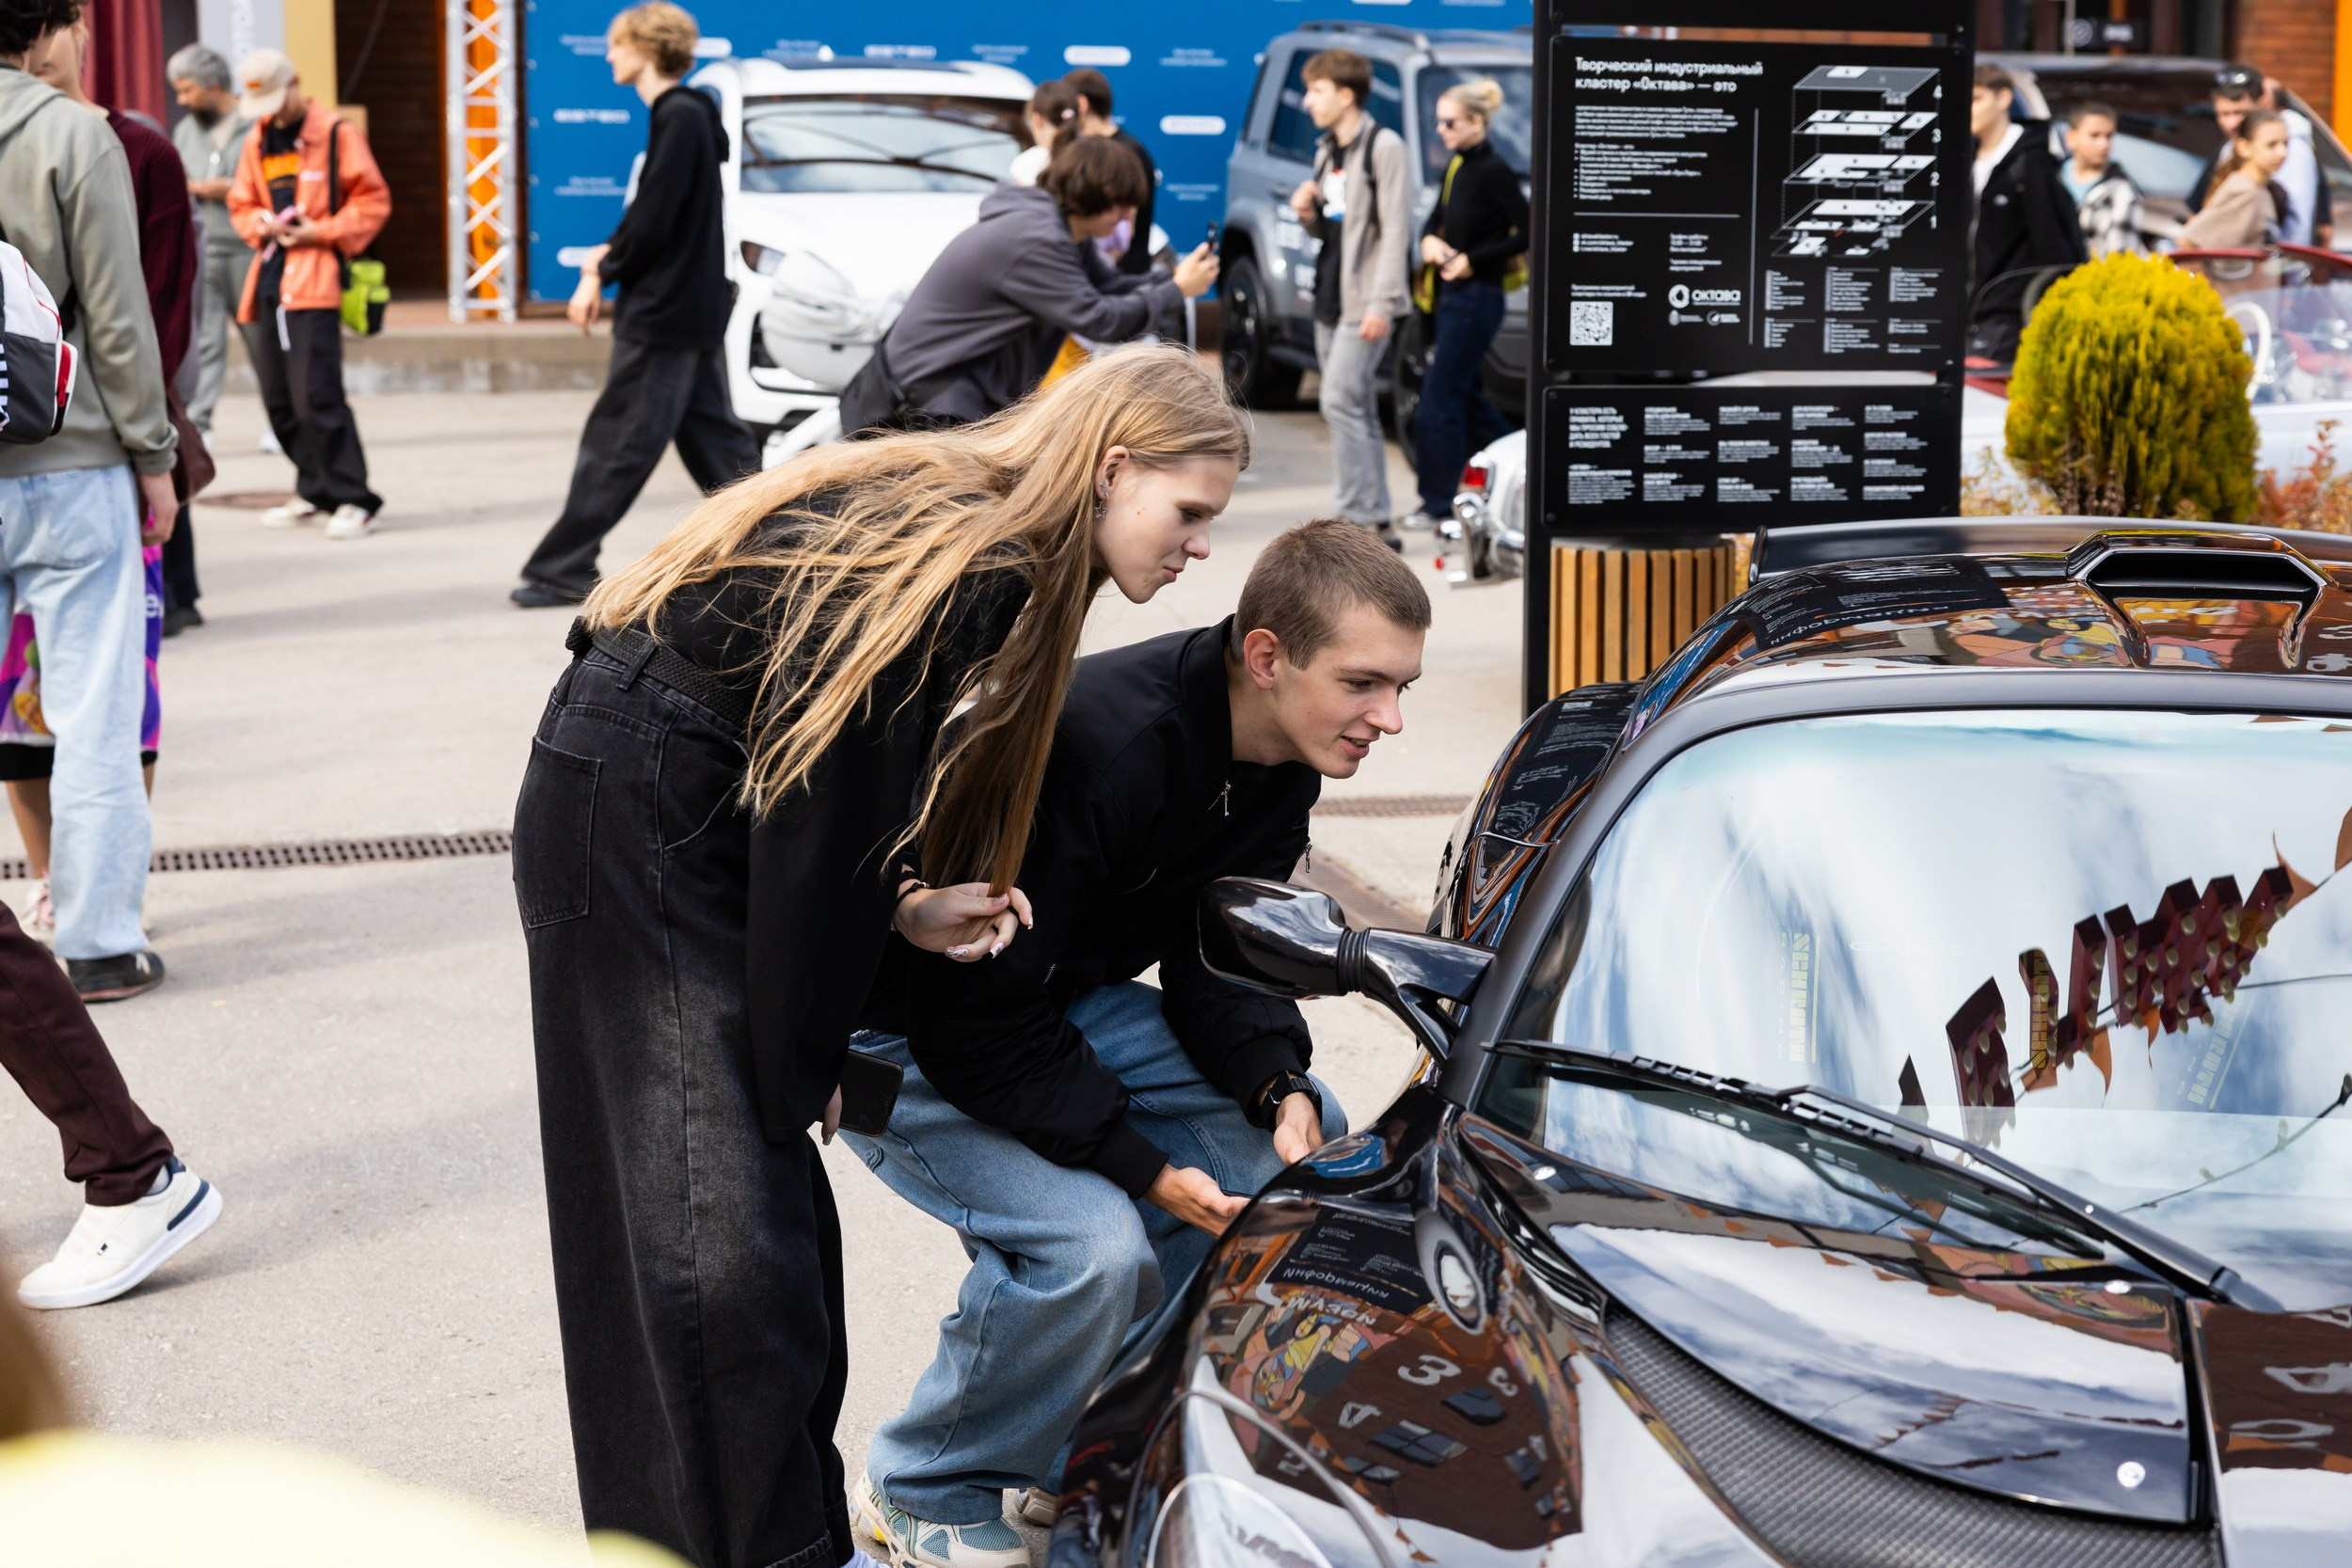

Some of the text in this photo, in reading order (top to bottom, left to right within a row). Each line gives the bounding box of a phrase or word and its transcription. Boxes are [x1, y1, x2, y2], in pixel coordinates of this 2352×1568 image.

[1575, 56, 1763, 77] Творческий индустриальный
[1575, 78, 1631, 93] кластер
[1632, 76, 1695, 91] «Октава»
[1712, 81, 1738, 92] это
[1931, 128, 1942, 143] 3
[1930, 171, 1939, 186] 2
[1931, 214, 1937, 230] 1
[1788, 932, 1810, 1063] SCHROTH
